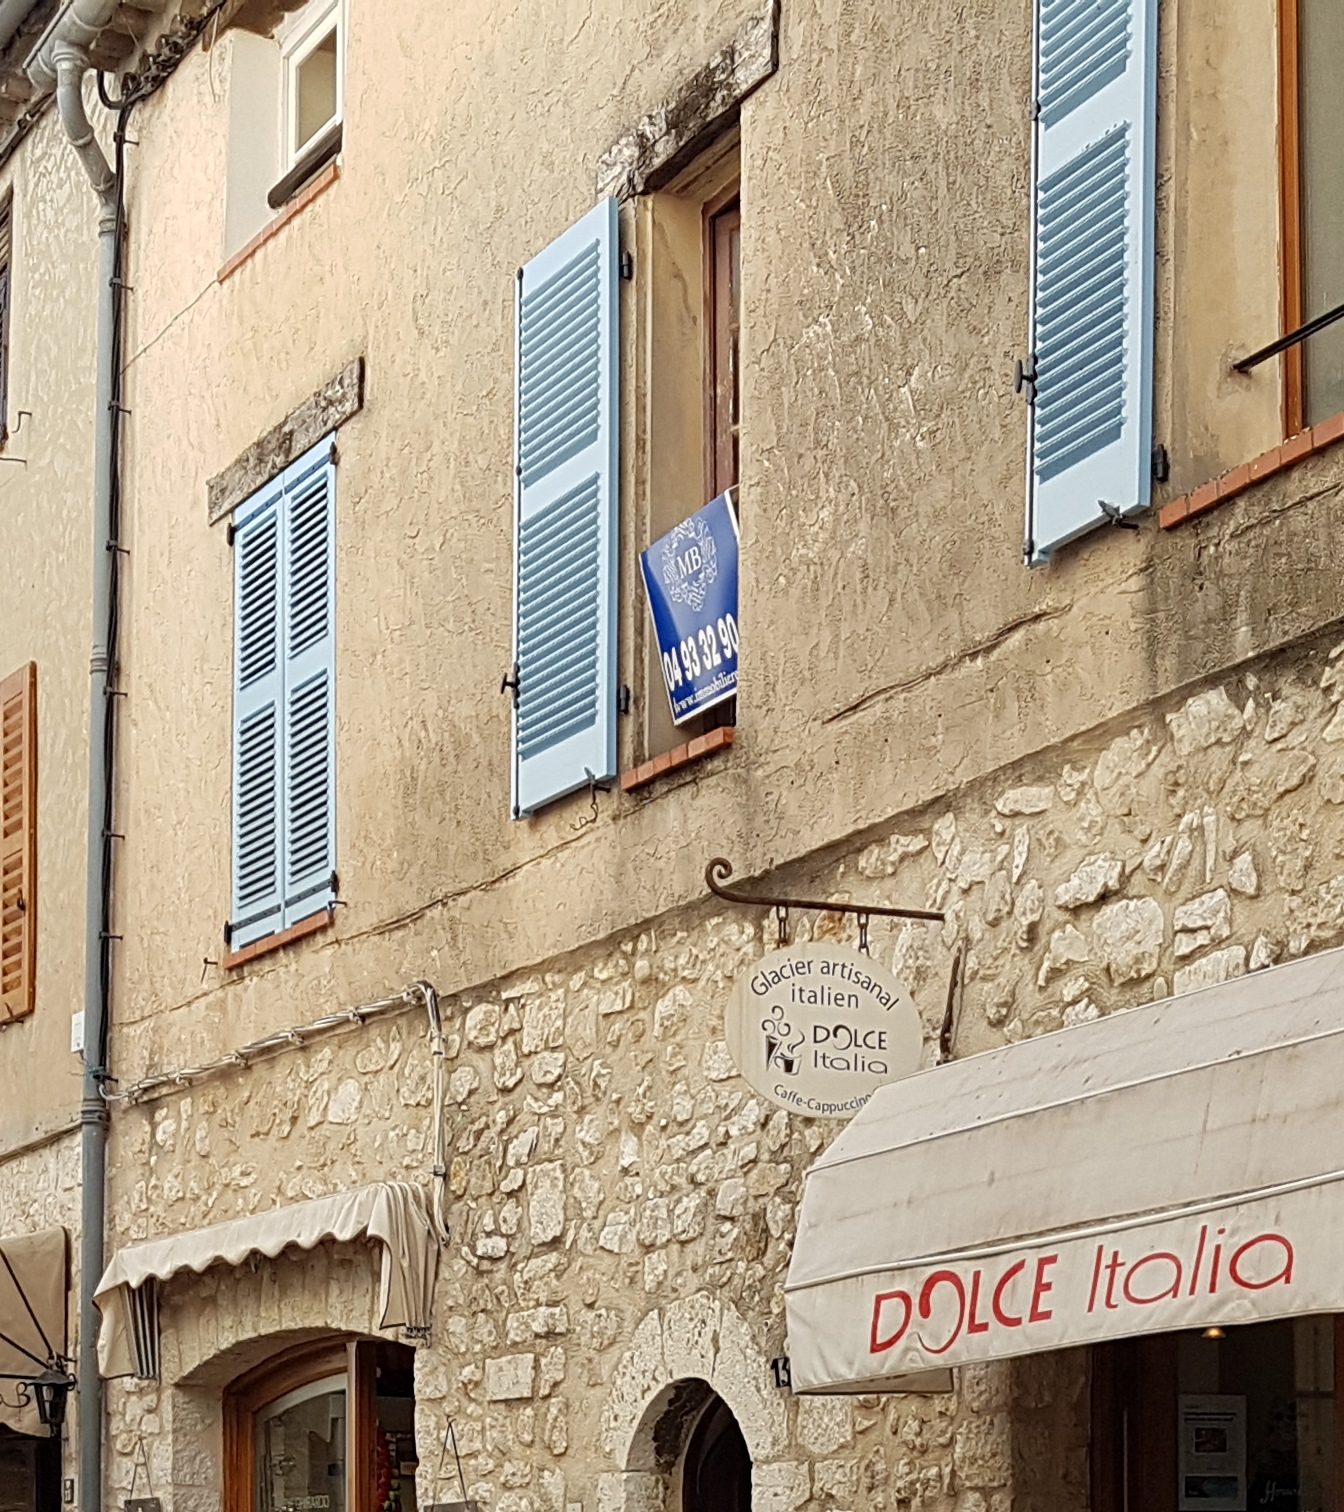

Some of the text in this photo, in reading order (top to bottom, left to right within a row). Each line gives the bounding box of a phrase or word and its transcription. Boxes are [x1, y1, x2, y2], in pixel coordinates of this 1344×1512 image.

[677, 545, 703, 580] MB
[663, 612, 739, 692] 04 93 32 90
[751, 959, 900, 1011] Glacier artisanal
[791, 983, 859, 1009] italien
[812, 1024, 888, 1051] DOLCE
[813, 1050, 888, 1075] Italia
[868, 1225, 1295, 1355] DOLCE Italia
